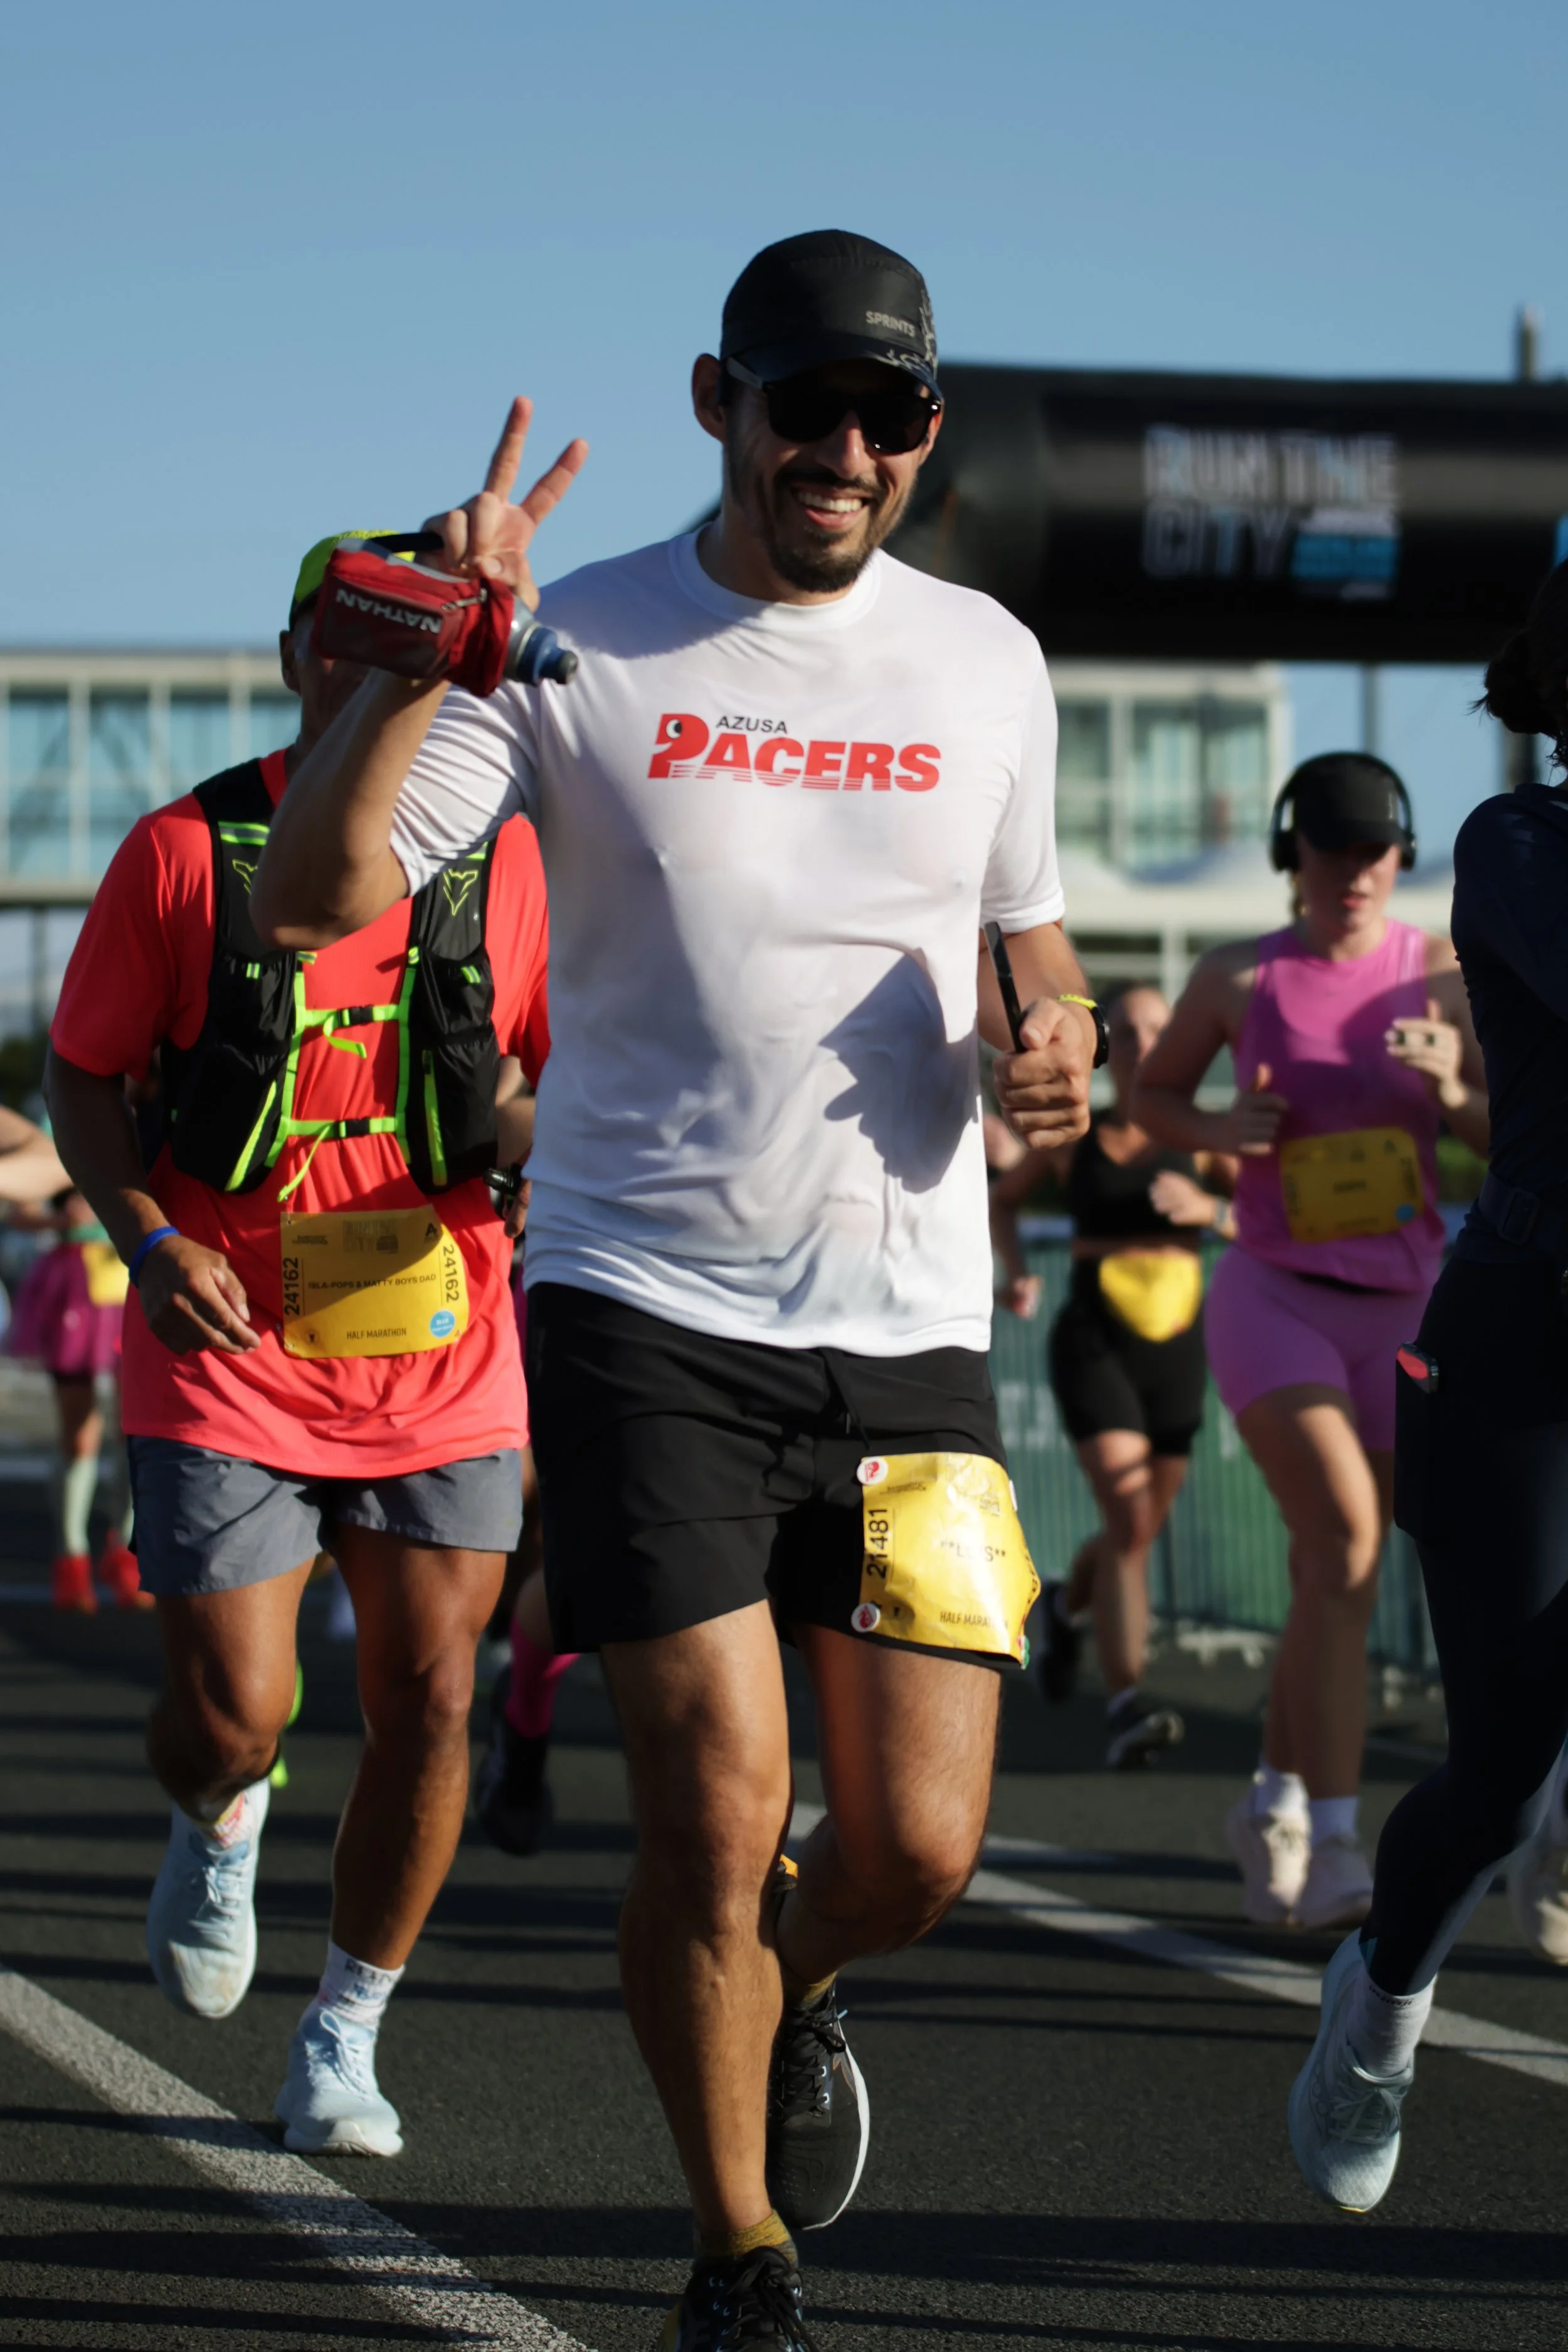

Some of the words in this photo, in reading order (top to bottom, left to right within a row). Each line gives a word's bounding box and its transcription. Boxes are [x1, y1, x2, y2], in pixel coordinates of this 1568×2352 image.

[866, 310, 916, 337] SPRINTS
[1143, 421, 1268, 502] RUN
[1143, 502, 1293, 578] CITY
[336, 588, 443, 634] NATHAN
[716, 715, 788, 734] AZUSA
[648, 713, 941, 792] PACERS
[283, 1257, 300, 1316] 24162
[364, 1278, 393, 1288] MATTY
[395, 1276, 418, 1286] BOYS
[419, 1274, 437, 1284] DAD
[443, 1244, 460, 1303] 24162
[346, 1329, 364, 1340] HALF
[366, 1328, 406, 1340] MARATHON
[866, 1509, 889, 1579] 21481
[940, 1610, 961, 1625] HALF
[963, 1613, 1008, 1630] MARATN
